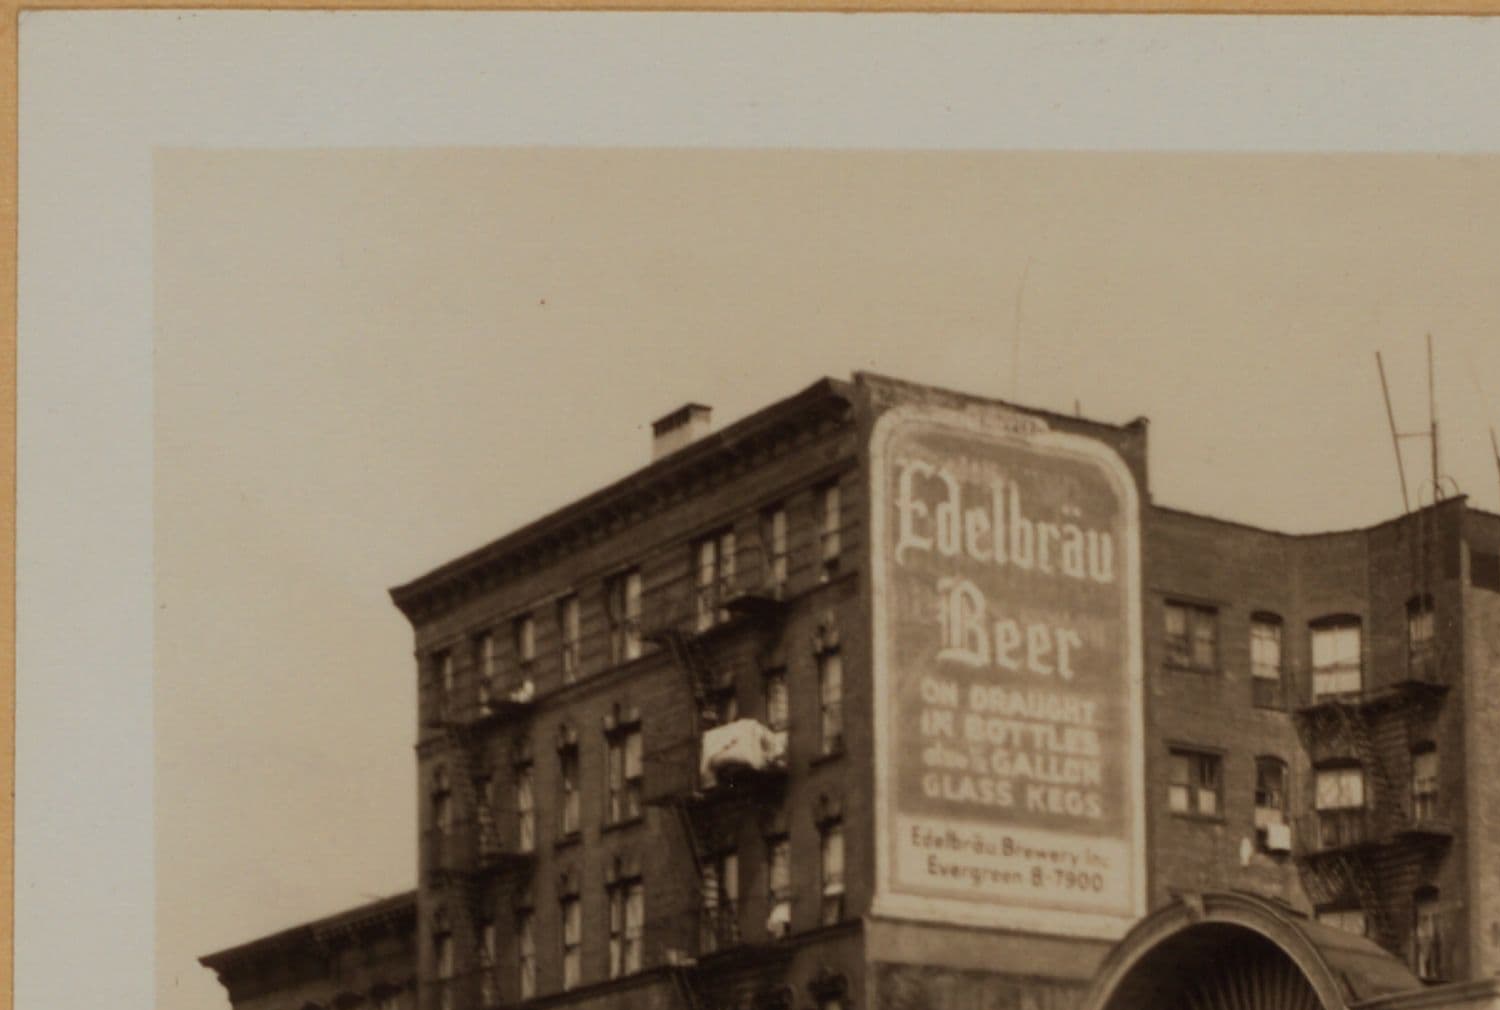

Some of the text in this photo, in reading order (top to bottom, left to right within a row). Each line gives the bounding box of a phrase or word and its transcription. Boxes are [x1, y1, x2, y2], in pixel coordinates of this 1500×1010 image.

[894, 458, 1115, 584] Edelbräu
[936, 577, 1083, 680] Beer
[921, 678, 1097, 726] ON DRAUGHT
[920, 708, 1101, 757] IN BOTTLES
[991, 748, 1102, 789] GALLON
[922, 772, 1103, 820] GLASS KEGS
[927, 854, 1023, 888] Evergreen
[1001, 835, 1077, 869] Brewery
